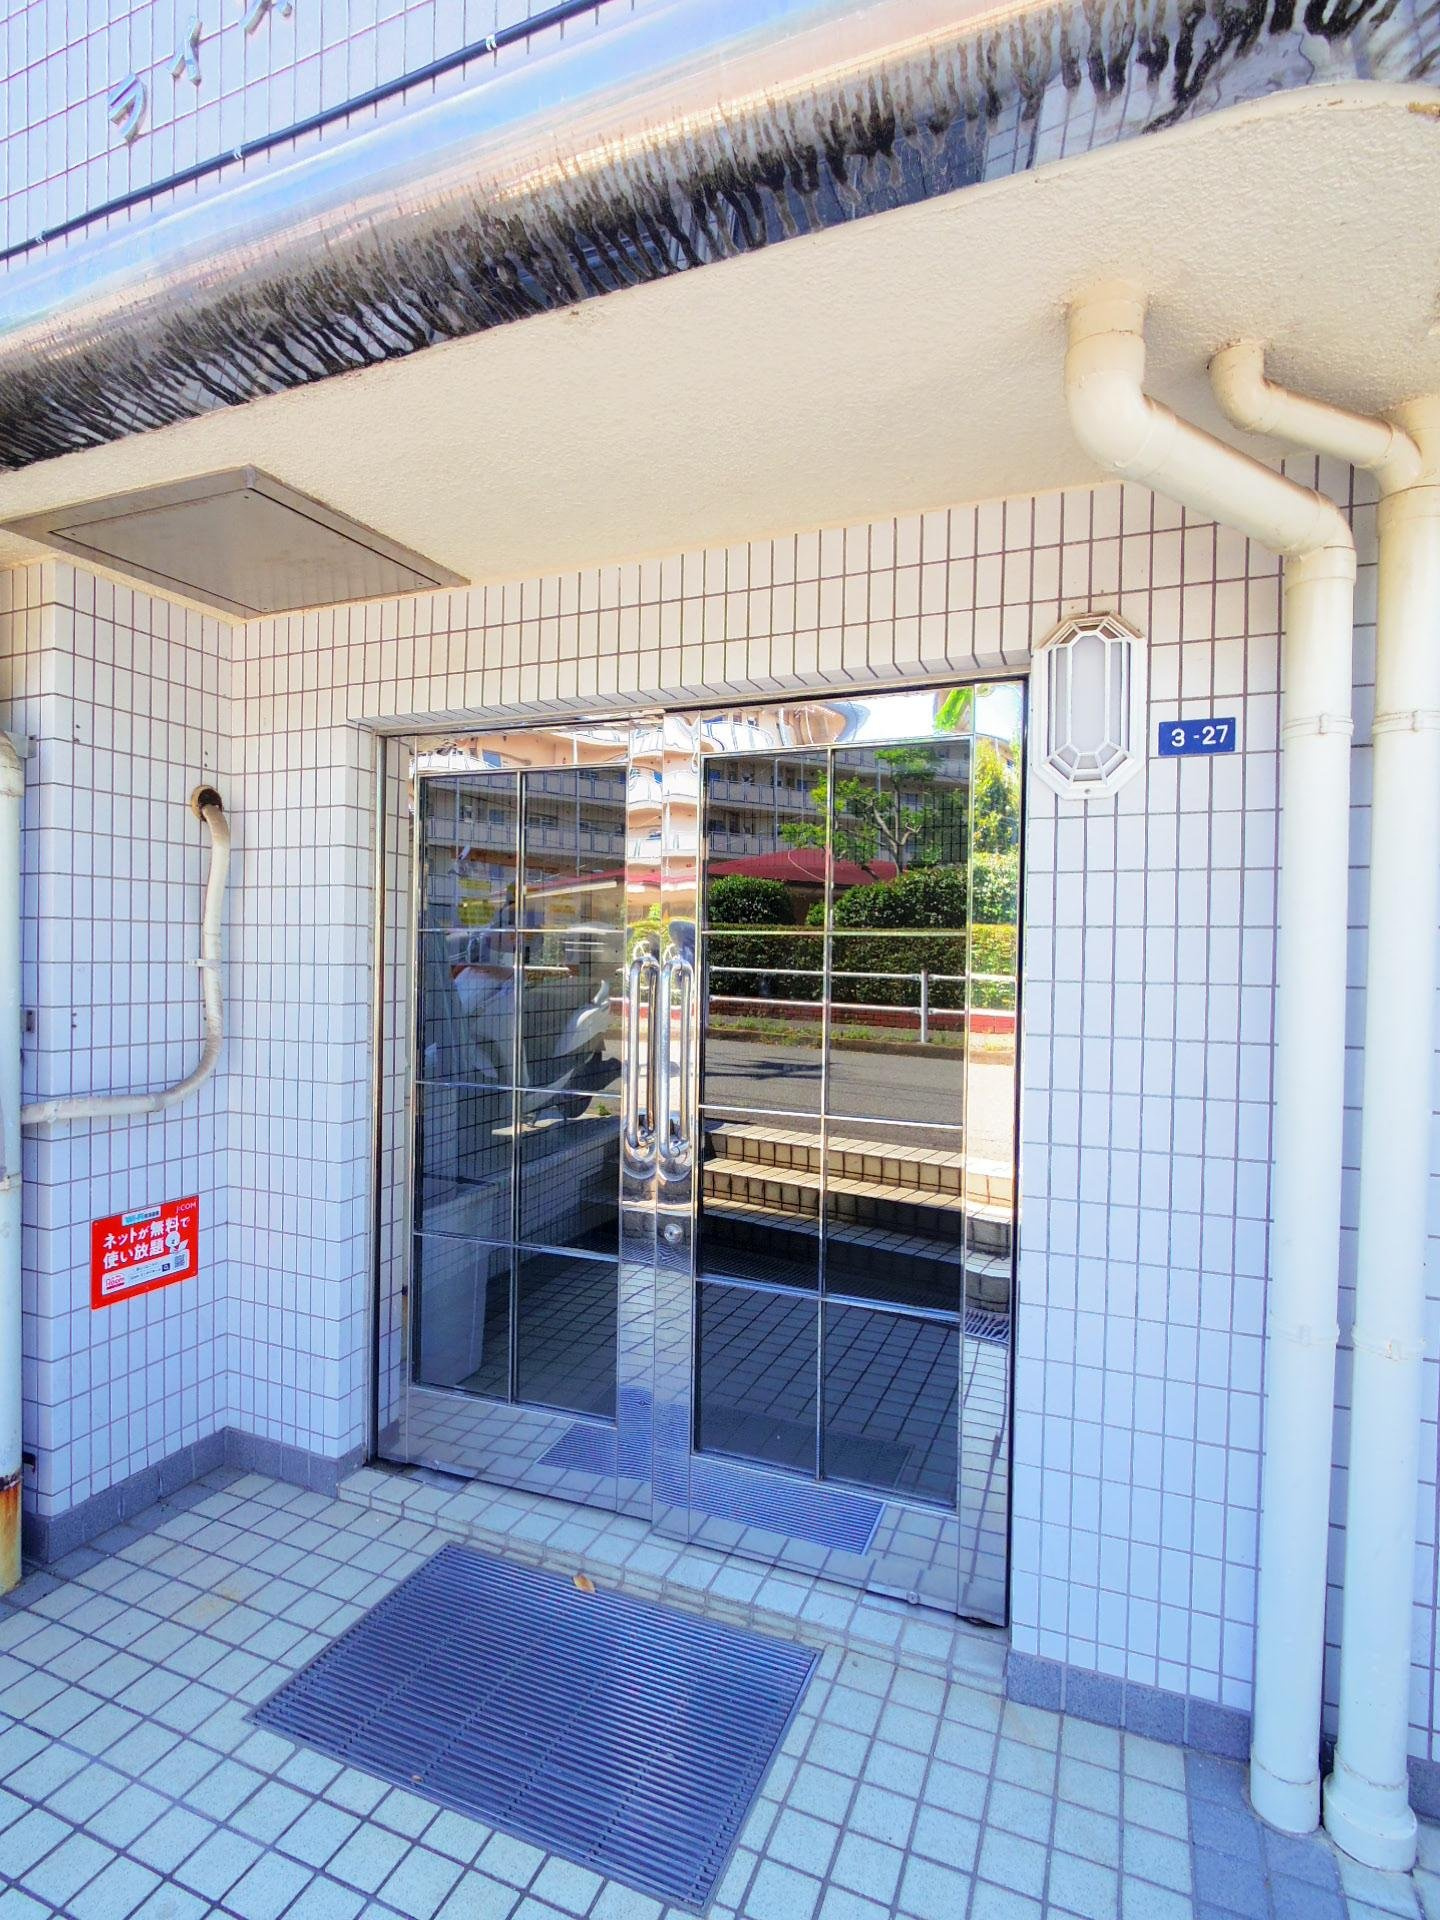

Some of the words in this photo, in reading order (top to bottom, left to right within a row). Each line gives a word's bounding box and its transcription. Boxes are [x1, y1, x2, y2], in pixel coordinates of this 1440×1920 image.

[103, 1216, 190, 1250] ネットが無料で
[103, 1237, 165, 1270] 使い放題
